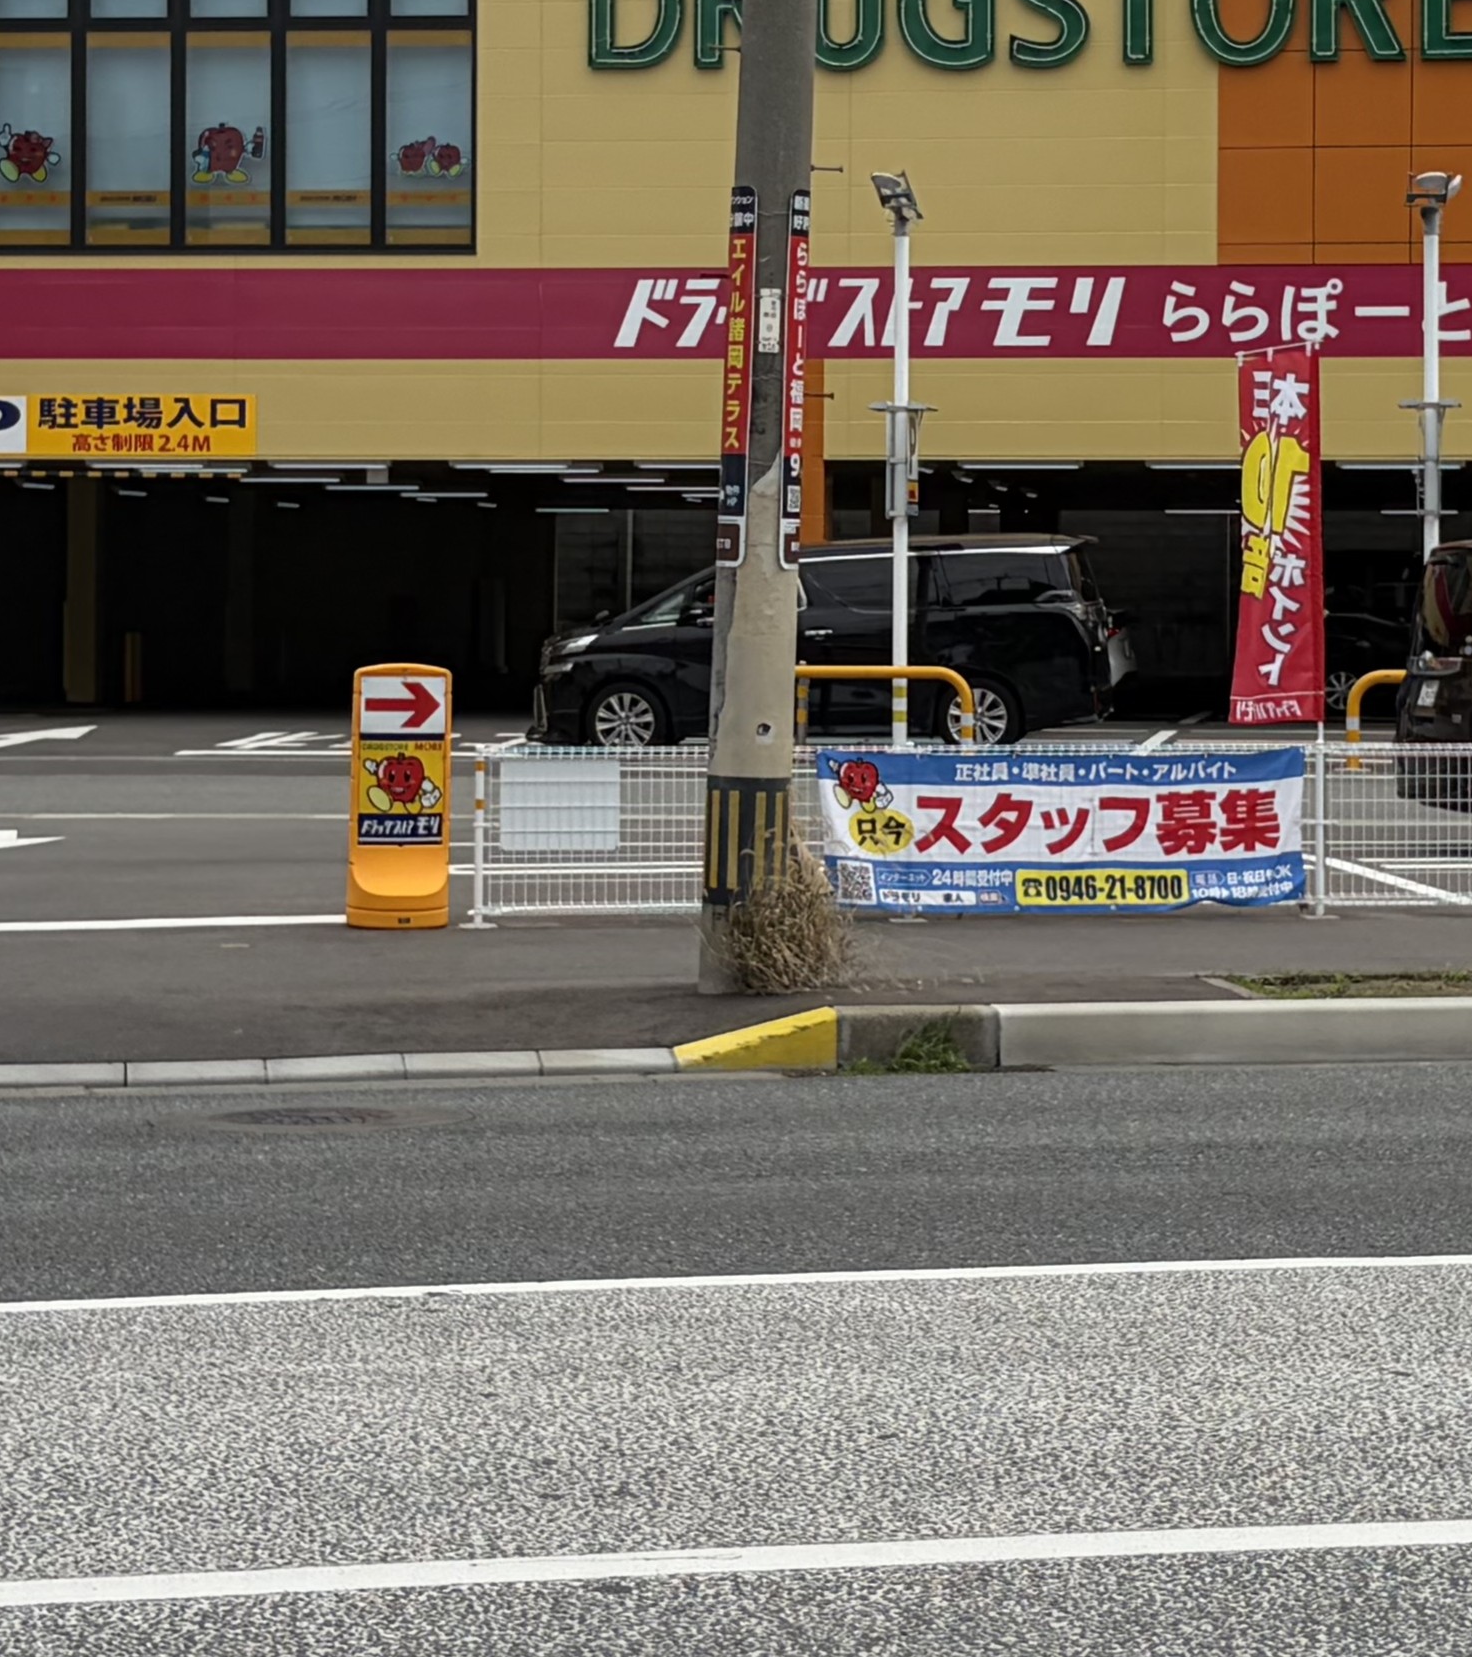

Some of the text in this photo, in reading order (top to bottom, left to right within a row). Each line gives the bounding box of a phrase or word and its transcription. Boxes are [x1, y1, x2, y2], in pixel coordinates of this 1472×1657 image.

[38, 396, 247, 429] 駐車場入口
[855, 816, 909, 847] 只今
[914, 788, 1281, 856] スタッフ募集
[1045, 873, 1182, 902] 0946-21-8700
